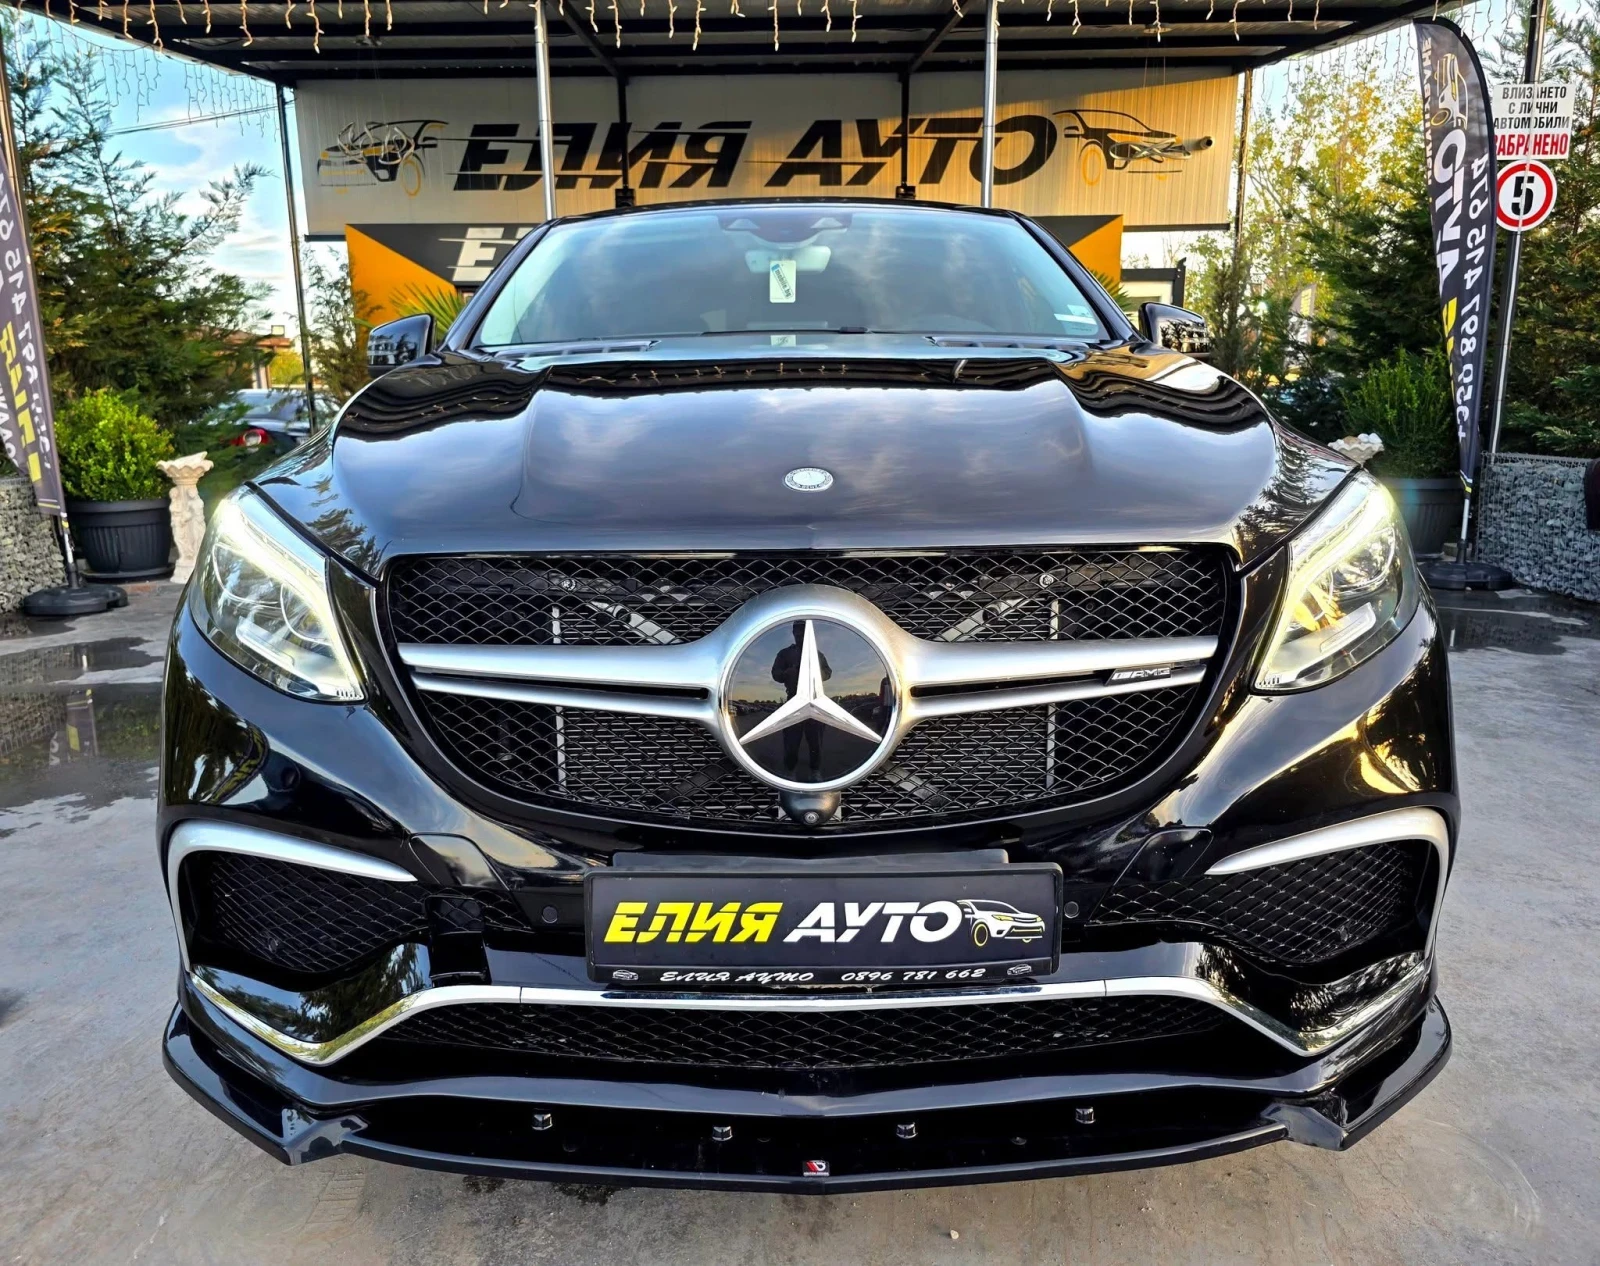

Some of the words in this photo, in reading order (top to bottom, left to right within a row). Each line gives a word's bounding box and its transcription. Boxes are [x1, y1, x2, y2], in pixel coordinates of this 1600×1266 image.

[1508, 102, 1516, 114] С
[453, 120, 752, 191] ЕЛИЯ
[764, 115, 1058, 187] АУТО
[1511, 176, 1535, 216] 5
[604, 902, 783, 943] ЕЛИЯ
[783, 900, 963, 943] АУТО
[841, 972, 893, 982] 0896
[903, 971, 937, 981] 781
[945, 968, 986, 979] 662
